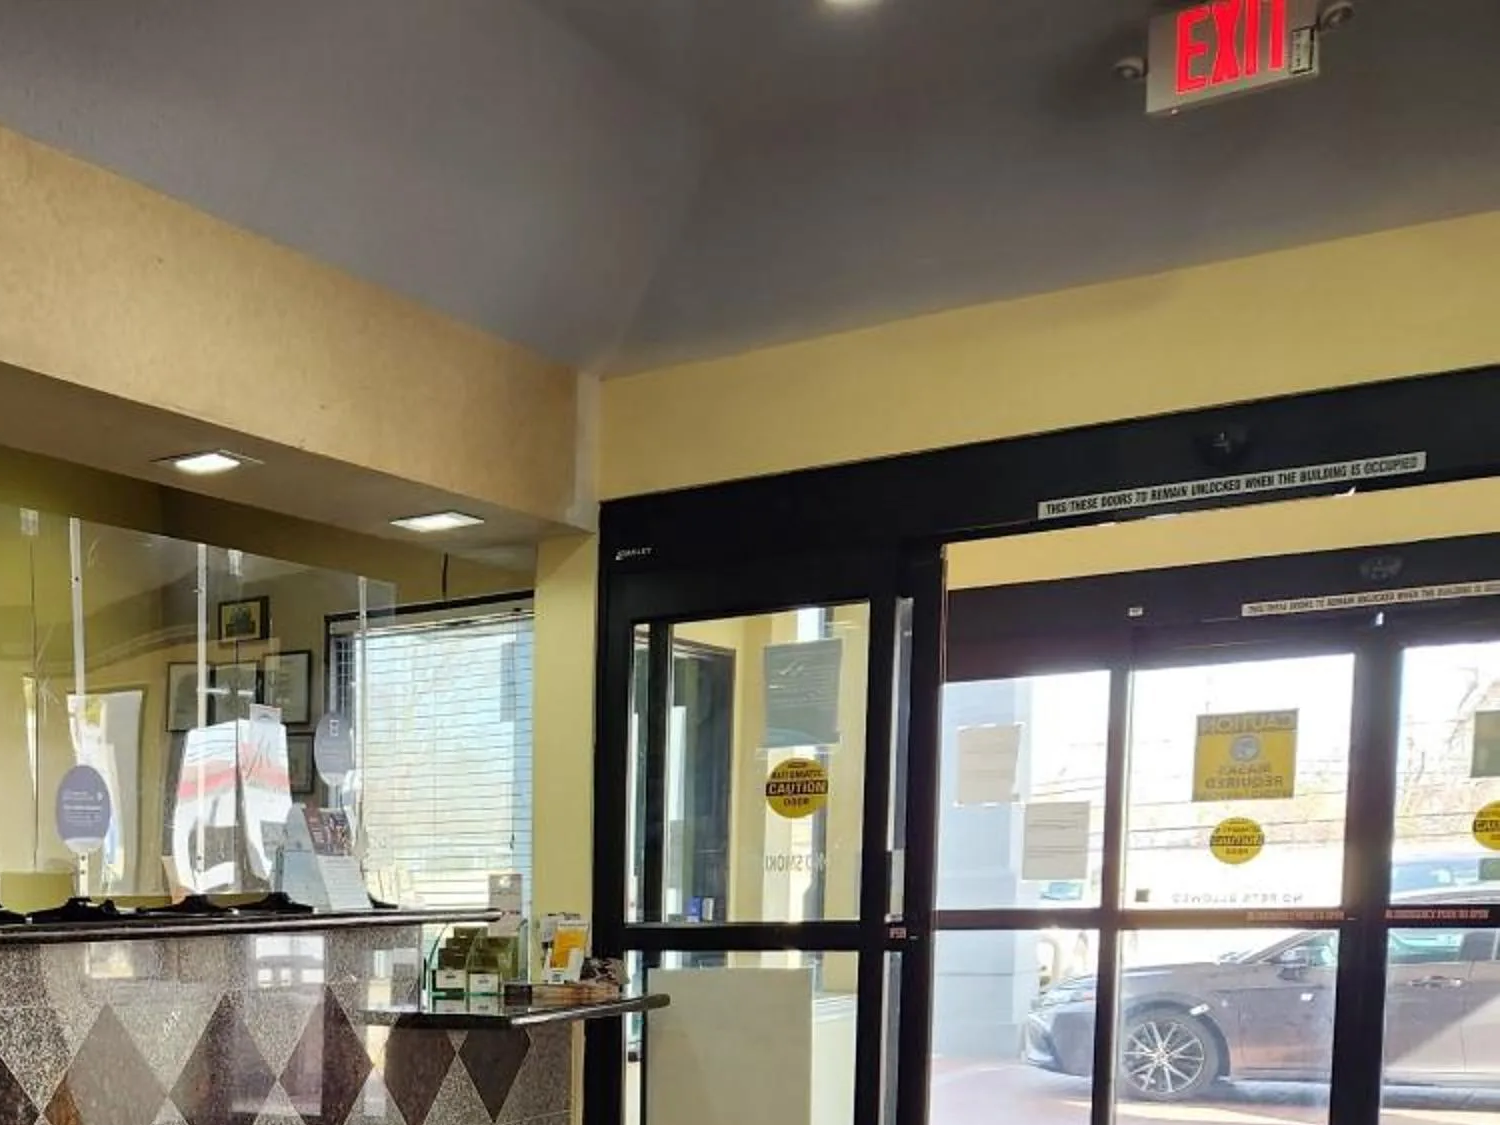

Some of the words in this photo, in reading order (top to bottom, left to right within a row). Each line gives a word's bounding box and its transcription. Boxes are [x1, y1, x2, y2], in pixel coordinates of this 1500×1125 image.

[1176, 0, 1286, 95] EXIT
[1046, 502, 1068, 515] THIS
[1071, 498, 1098, 512] THESE
[1101, 493, 1133, 508] DOORS
[1135, 490, 1148, 503] TO
[1151, 486, 1188, 501] REMAIN
[1191, 478, 1241, 497] UNLOCKED
[1245, 476, 1275, 490] WHEN
[1278, 472, 1296, 485] THE
[1300, 465, 1347, 483] BUILDING
[1351, 463, 1361, 476] IS
[1364, 455, 1418, 474] OCCUPIED
[768, 780, 826, 796] CAUTION
